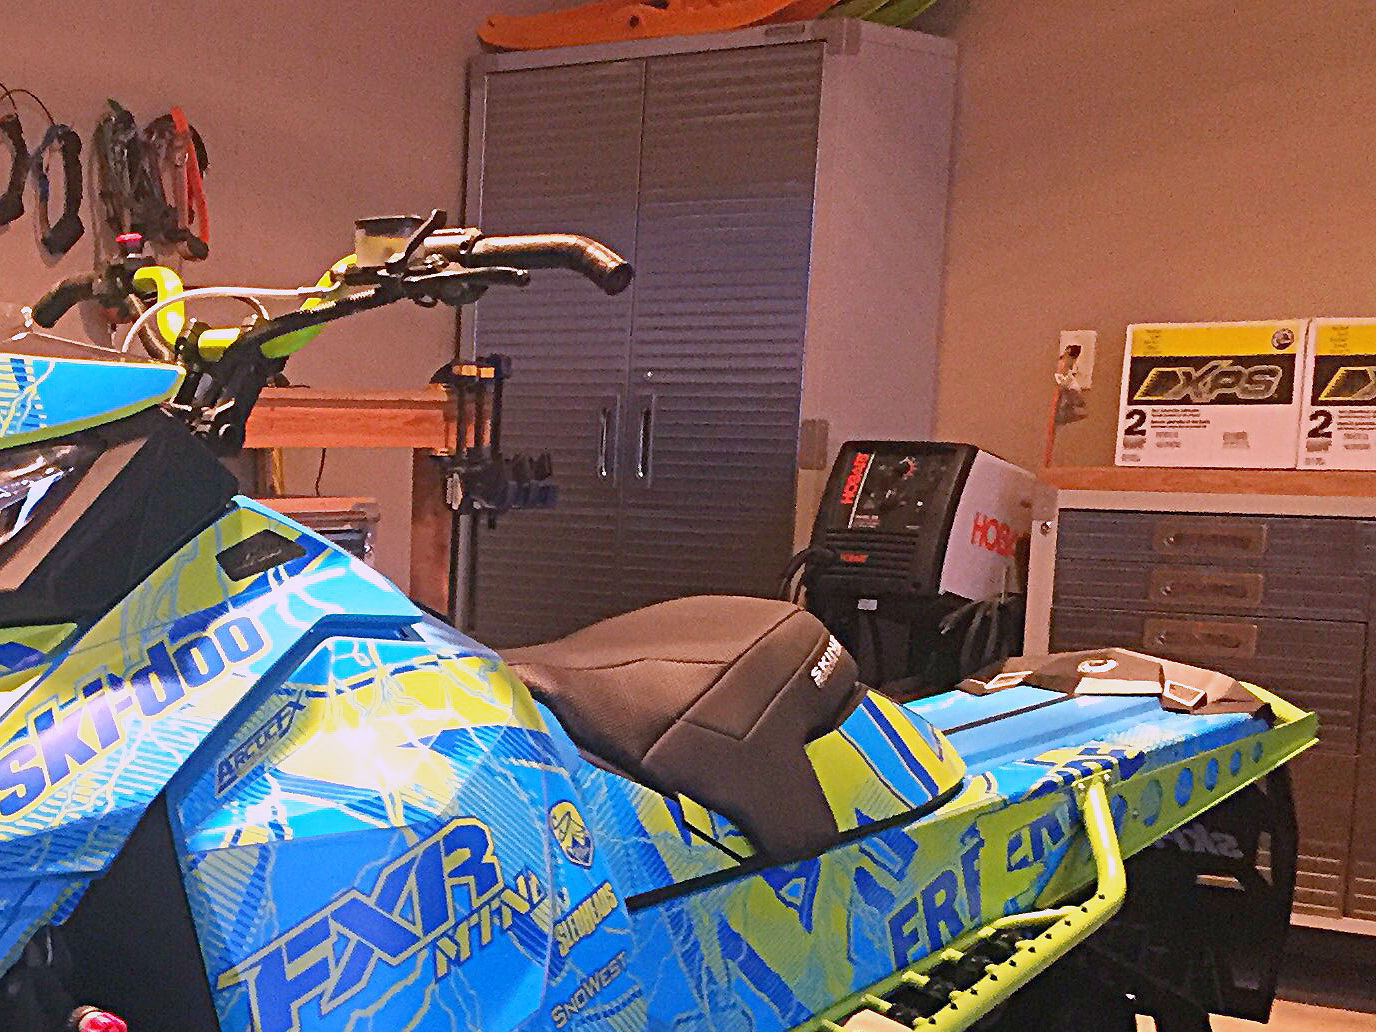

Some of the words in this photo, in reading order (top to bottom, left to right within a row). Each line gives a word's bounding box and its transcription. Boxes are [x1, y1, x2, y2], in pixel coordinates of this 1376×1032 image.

[1161, 359, 1284, 404] XPS
[1124, 408, 1147, 437] 2
[1307, 409, 1333, 439] 2
